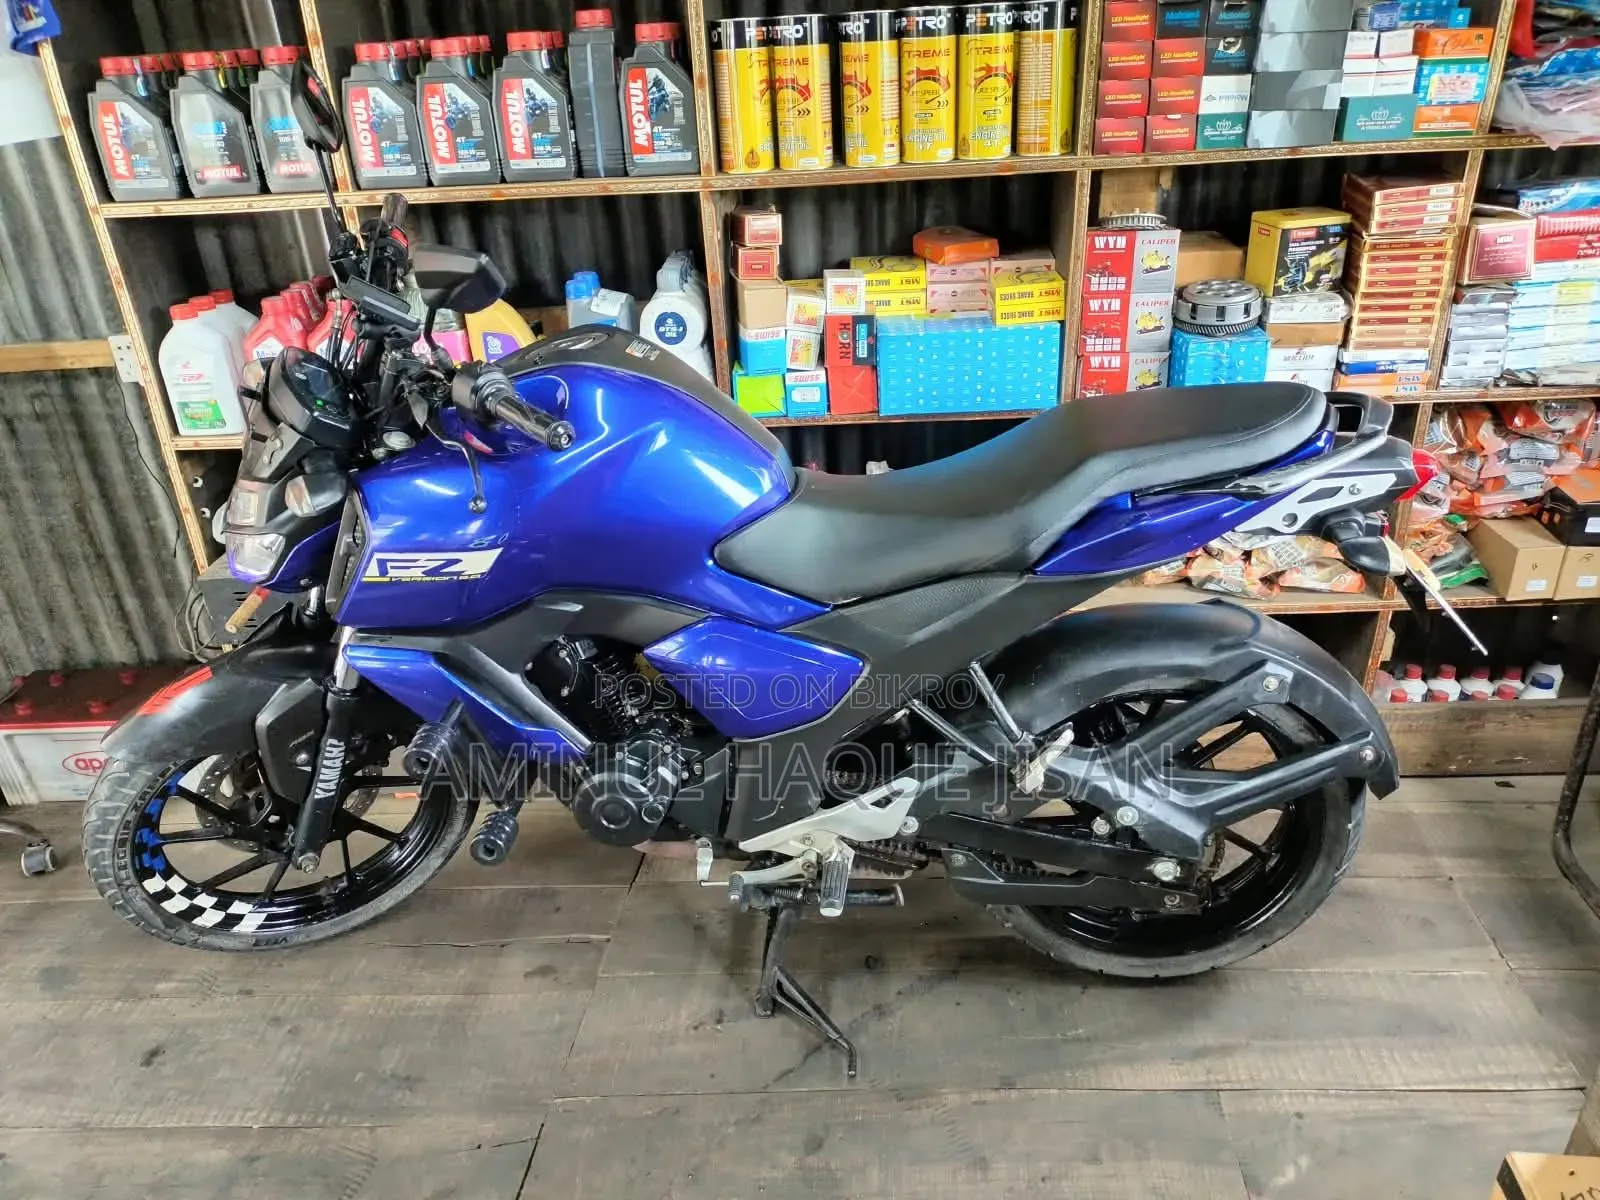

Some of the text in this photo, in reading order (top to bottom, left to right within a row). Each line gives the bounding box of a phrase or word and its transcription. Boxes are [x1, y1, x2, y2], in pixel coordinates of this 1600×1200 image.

[900, 16, 947, 32] PETRO
[966, 12, 1013, 28] PETRO
[505, 91, 527, 154] MOTUL
[628, 79, 649, 147] MOTUL
[352, 99, 377, 162] MOTUL
[427, 95, 450, 159] MOTUL
[101, 111, 130, 177] MOTUL
[203, 167, 240, 178] MOTUL
[280, 163, 313, 174] MOTUL
[1141, 238, 1176, 246] CALIPER
[1135, 300, 1169, 308] CALIPER
[839, 322, 850, 360] HORN
[1134, 358, 1165, 366] CALIPE
[313, 738, 346, 799] YAMAHA
